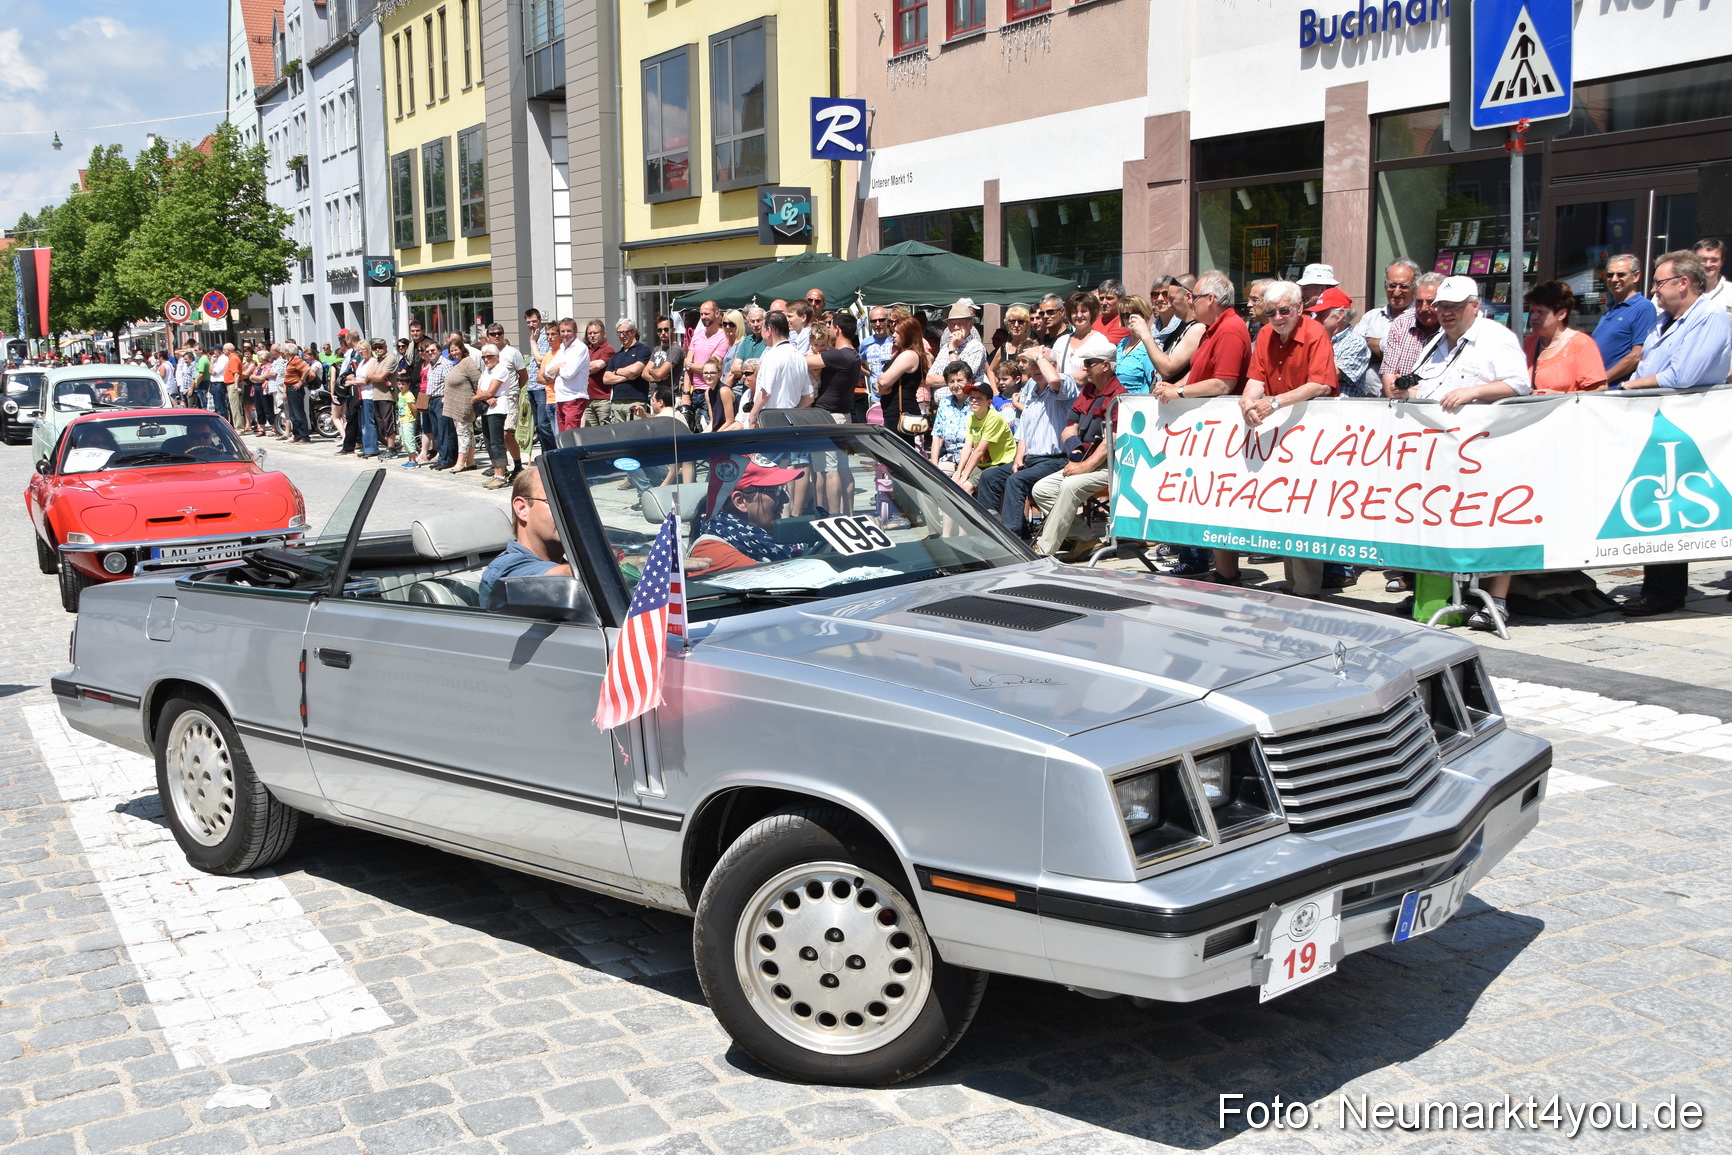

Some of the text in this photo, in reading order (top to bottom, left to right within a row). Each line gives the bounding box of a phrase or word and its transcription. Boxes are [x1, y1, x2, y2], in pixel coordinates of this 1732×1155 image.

[871, 172, 914, 189] Unterer Markt 15
[780, 202, 799, 227] G2
[375, 264, 386, 277] G2
[170, 304, 186, 317] 30
[1225, 424, 1306, 464] UNS
[1327, 478, 1544, 528] BESSER.
[815, 517, 892, 554] 195
[1203, 530, 1282, 549] Service-Line:
[1595, 546, 1619, 558] Jura
[1622, 540, 1674, 556] Gebäude
[1677, 536, 1717, 553] Service
[1412, 893, 1433, 932] R
[1400, 921, 1408, 933] D
[1283, 941, 1317, 980] 19
